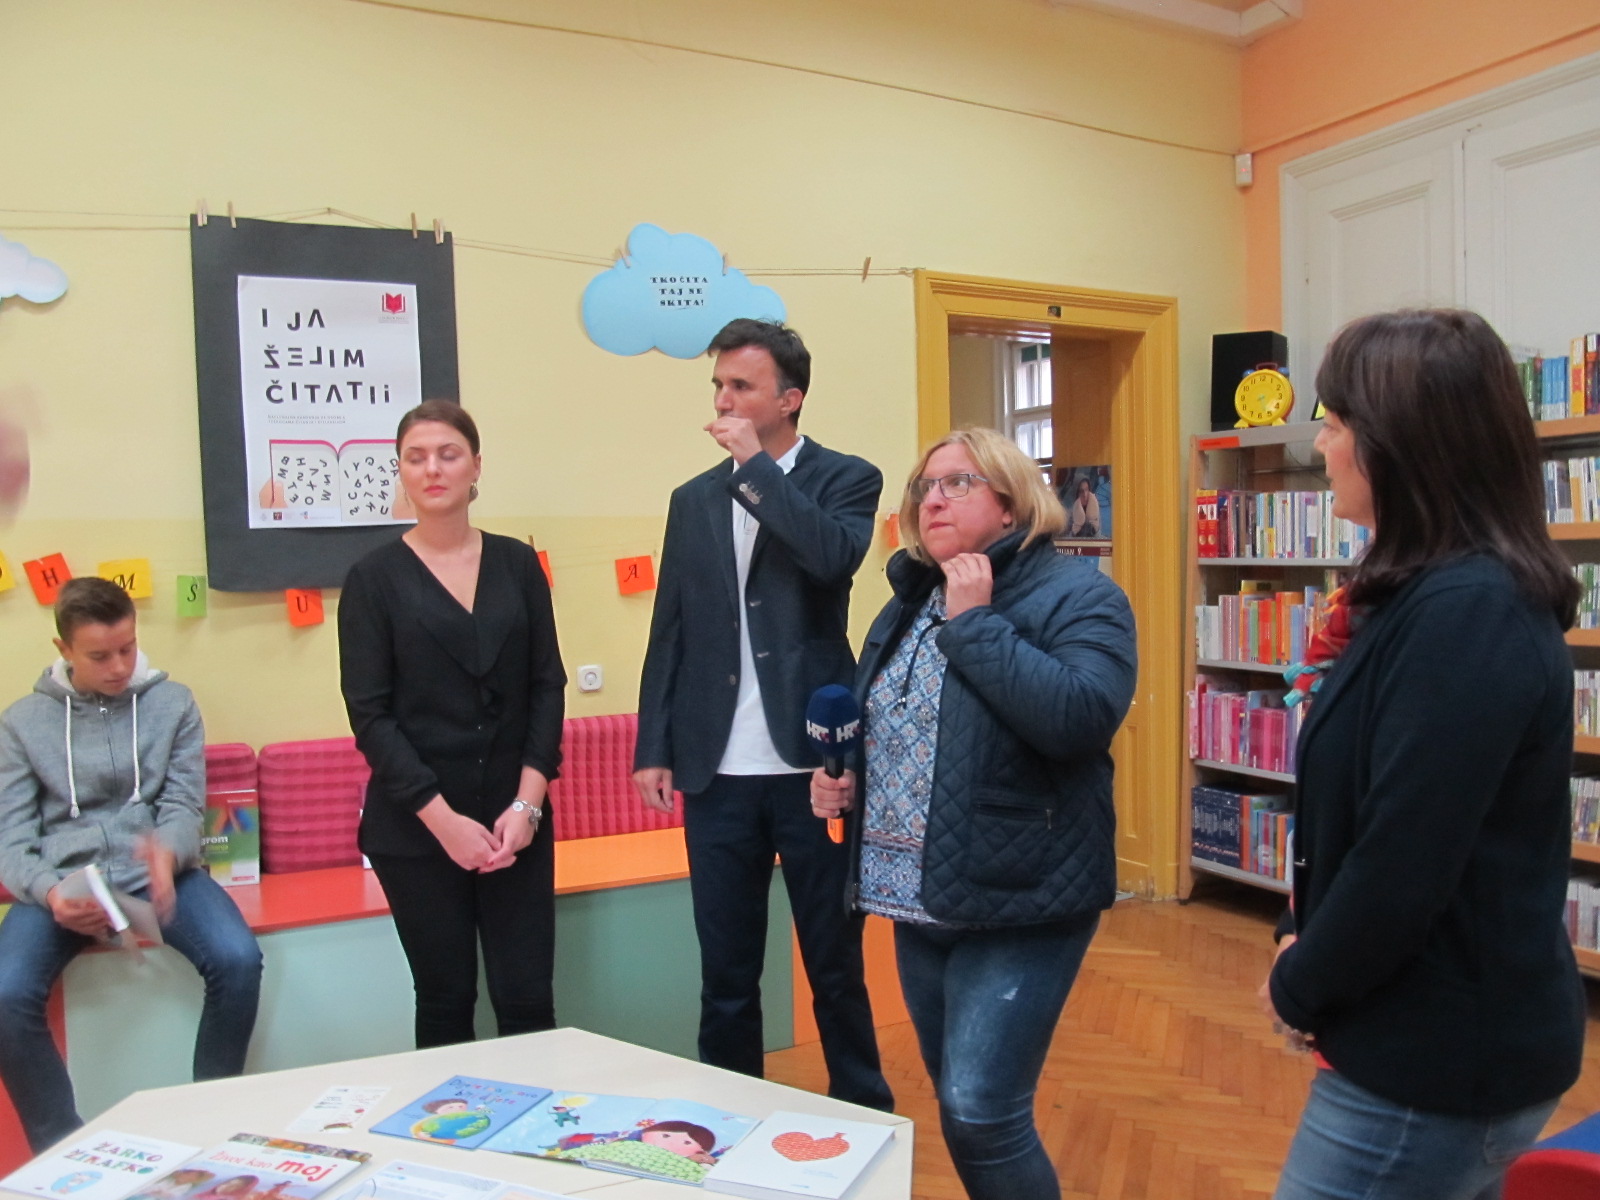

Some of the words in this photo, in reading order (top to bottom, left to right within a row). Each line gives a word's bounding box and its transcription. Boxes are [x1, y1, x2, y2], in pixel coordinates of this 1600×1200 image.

[262, 308, 268, 328] I
[287, 308, 325, 331] JA
[41, 567, 59, 588] H
[112, 573, 136, 591] M
[623, 563, 639, 583] A
[187, 584, 198, 602] S
[296, 596, 309, 613] U
[275, 1160, 338, 1182] moj
